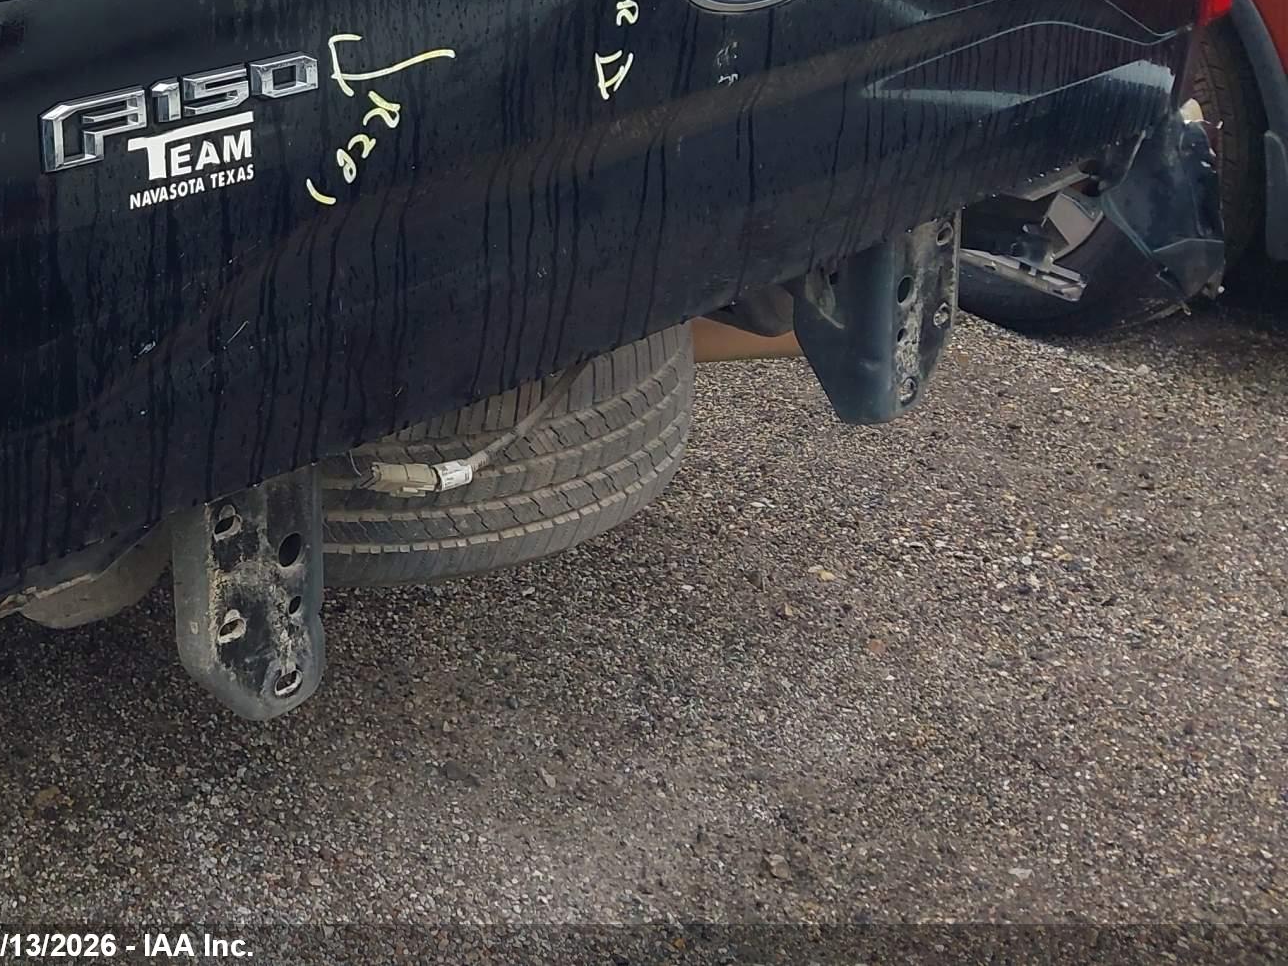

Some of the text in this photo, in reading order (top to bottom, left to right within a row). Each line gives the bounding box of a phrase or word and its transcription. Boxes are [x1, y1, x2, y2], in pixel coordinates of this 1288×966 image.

[127, 111, 254, 181] TEAM
[129, 163, 255, 210] NAVASOTA TEXAS
